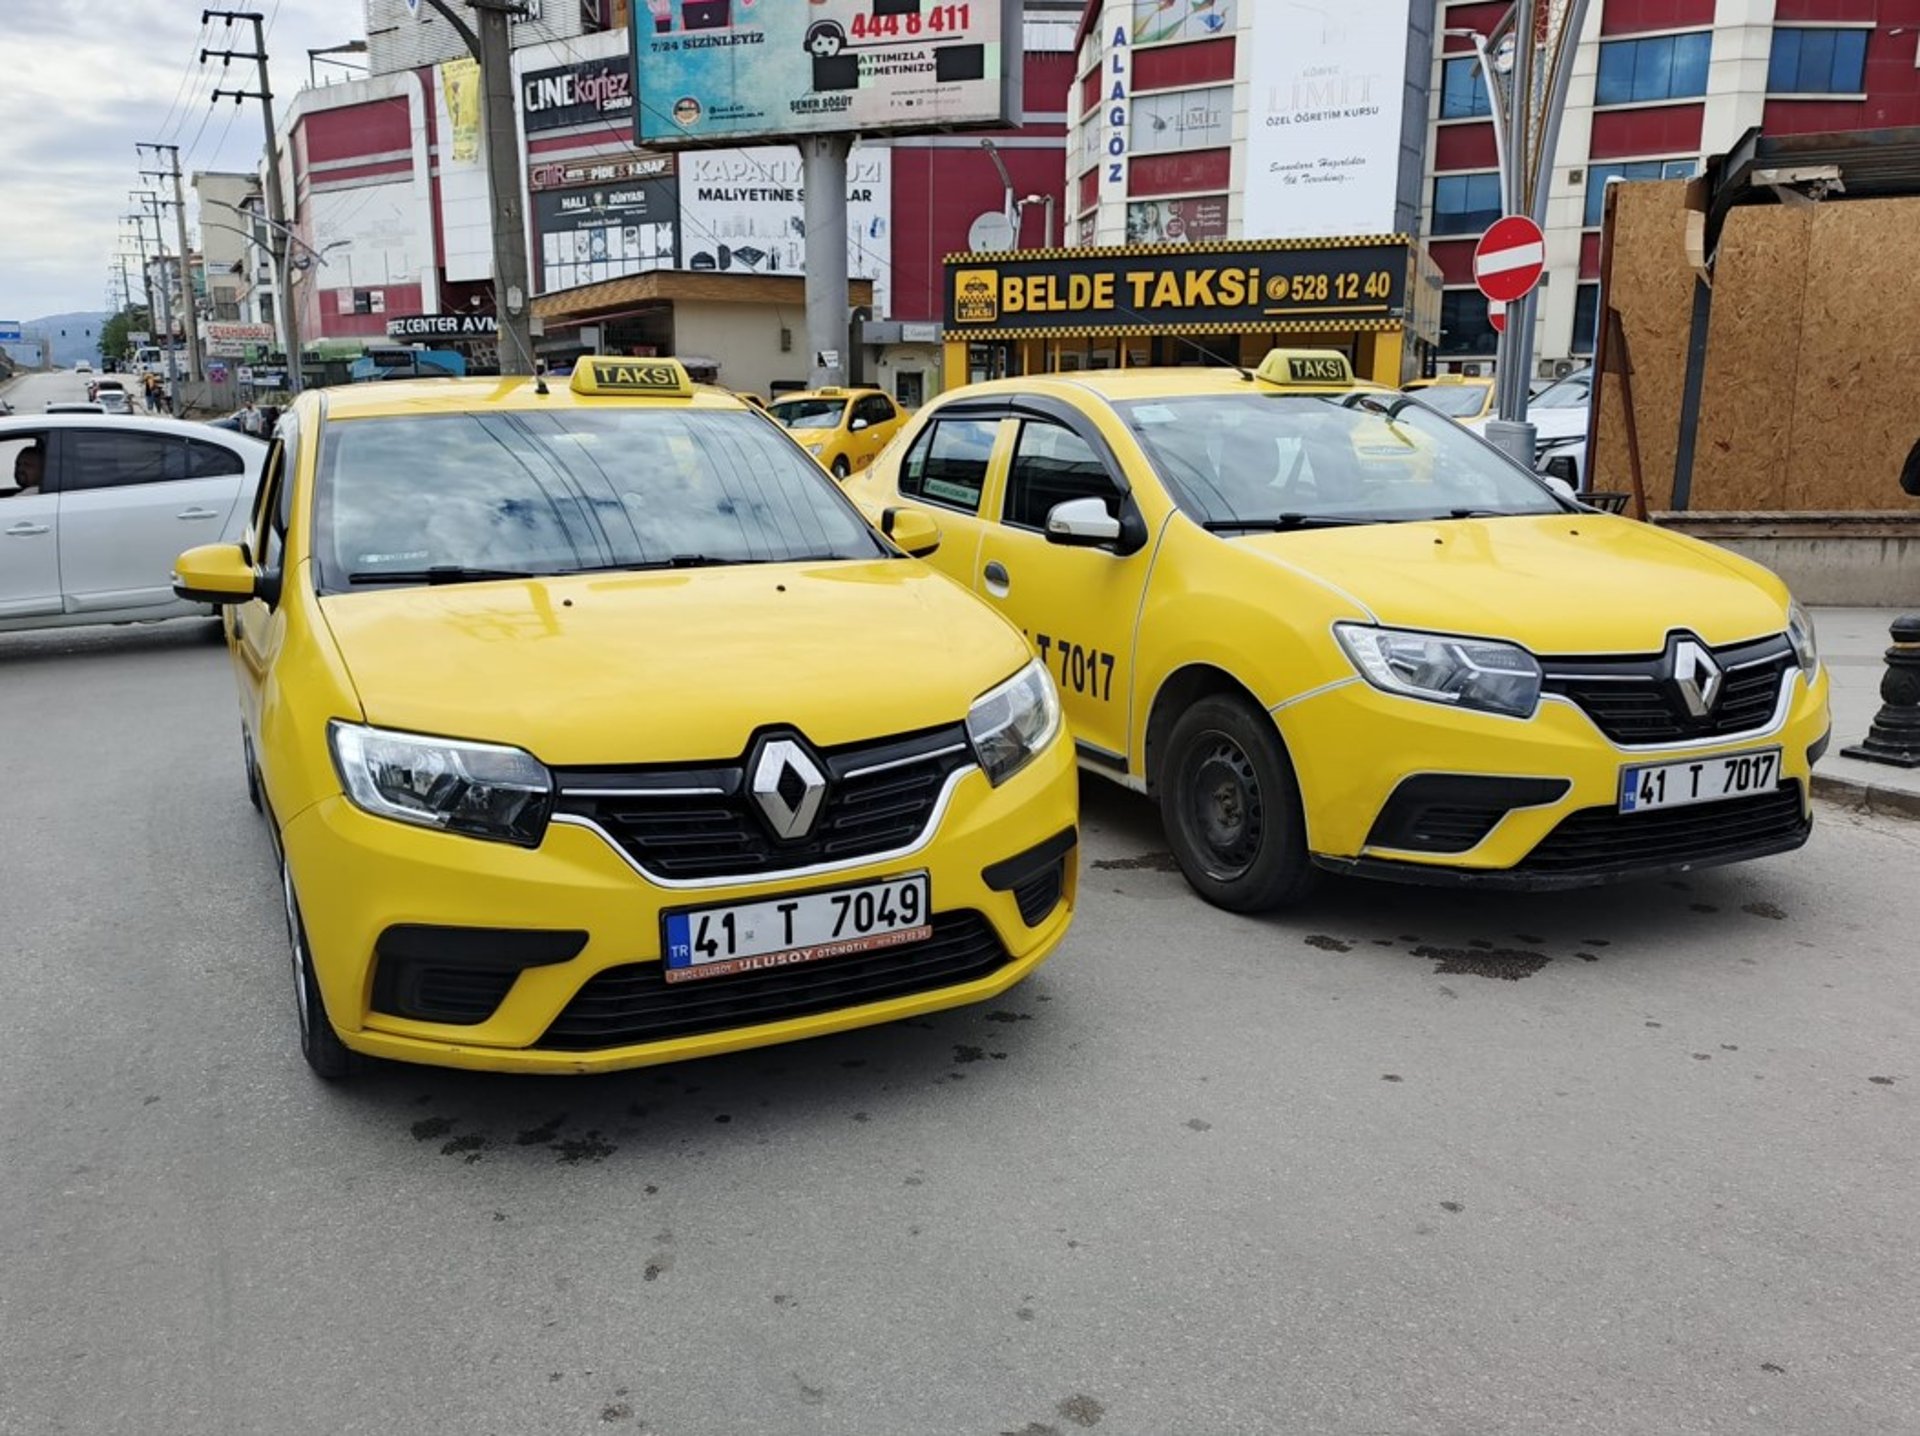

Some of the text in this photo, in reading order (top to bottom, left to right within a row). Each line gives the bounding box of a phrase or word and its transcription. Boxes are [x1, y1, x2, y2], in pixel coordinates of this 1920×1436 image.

[851, 4, 969, 37] 444 8 411
[651, 32, 765, 52] 7/24 SİZİNLEYİZ
[859, 51, 925, 64] ATTIMIZLA
[1108, 26, 1127, 182] ALAGÖZ
[1266, 115, 1291, 126] ÖZEL
[1344, 106, 1379, 118] KURSU
[1002, 273, 1115, 312] BELDE
[1291, 274, 1328, 300] 528
[1335, 273, 1360, 299] 12
[1364, 271, 1391, 298] 40
[406, 317, 458, 333] CENTER
[1058, 640, 1114, 701] 7017
[1640, 769, 1665, 803] 41
[1690, 765, 1703, 798] T
[1723, 755, 1775, 793] 7017
[671, 883, 919, 958] TR 41 T 7049
[739, 950, 812, 971] ULUSOY
